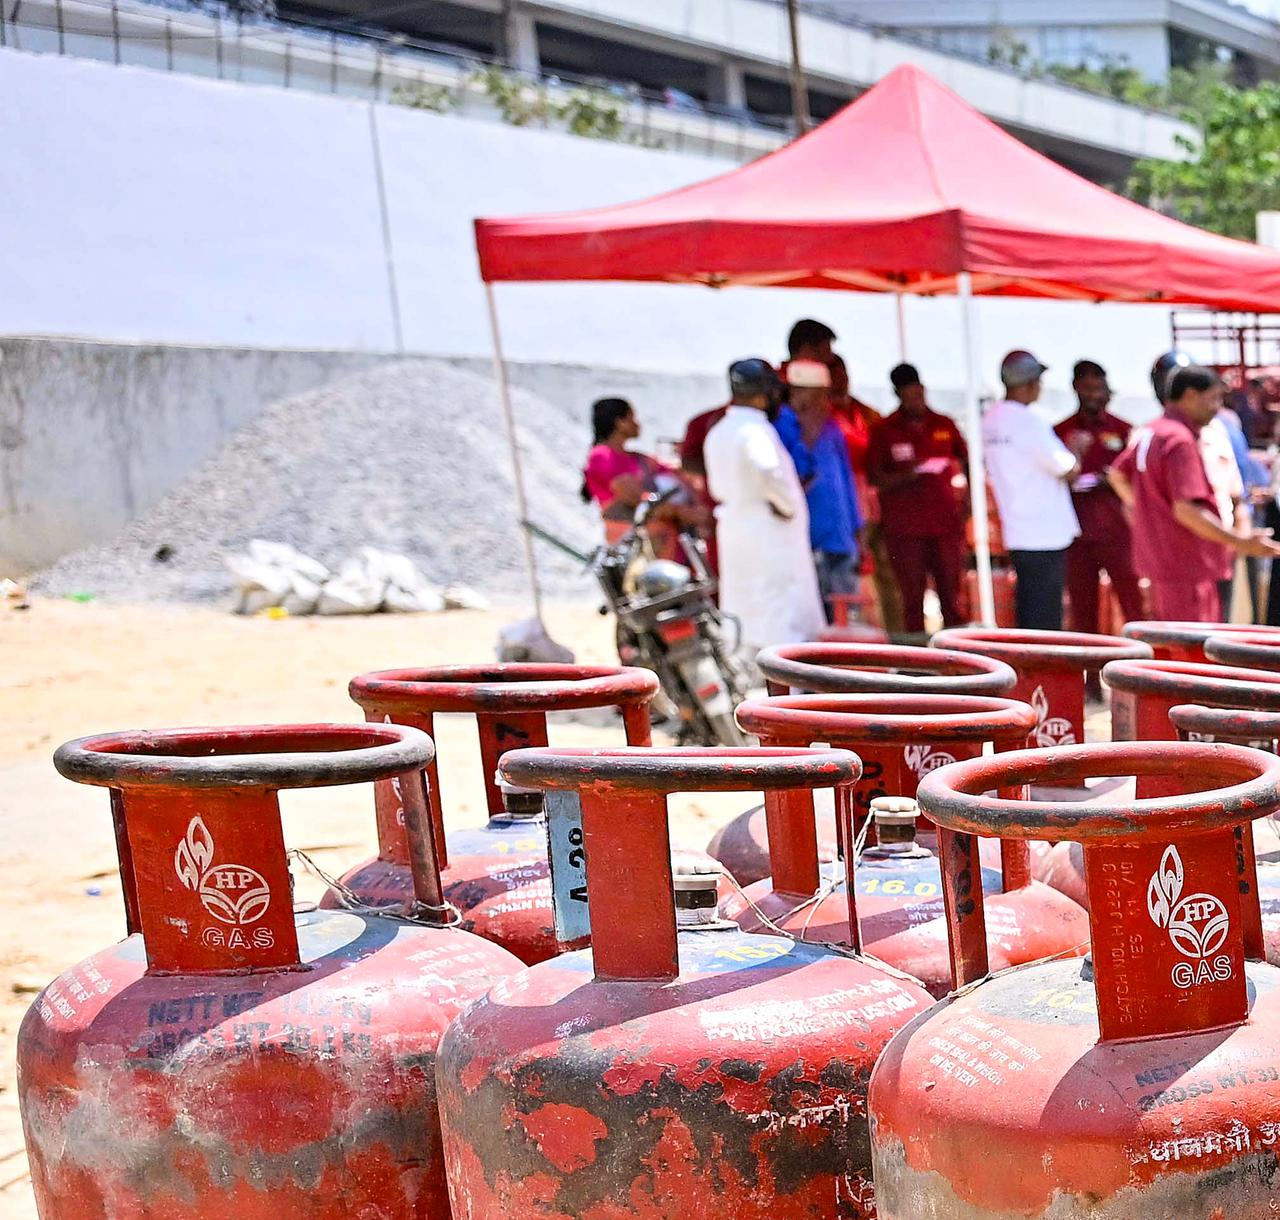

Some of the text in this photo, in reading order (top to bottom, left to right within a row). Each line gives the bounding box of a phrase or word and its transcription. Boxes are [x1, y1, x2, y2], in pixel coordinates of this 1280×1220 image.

[214, 872, 254, 890] HP
[861, 879, 937, 896] 16.0
[1182, 901, 1216, 922] HP
[201, 927, 275, 949] GAS
[1171, 954, 1232, 988] GAS
